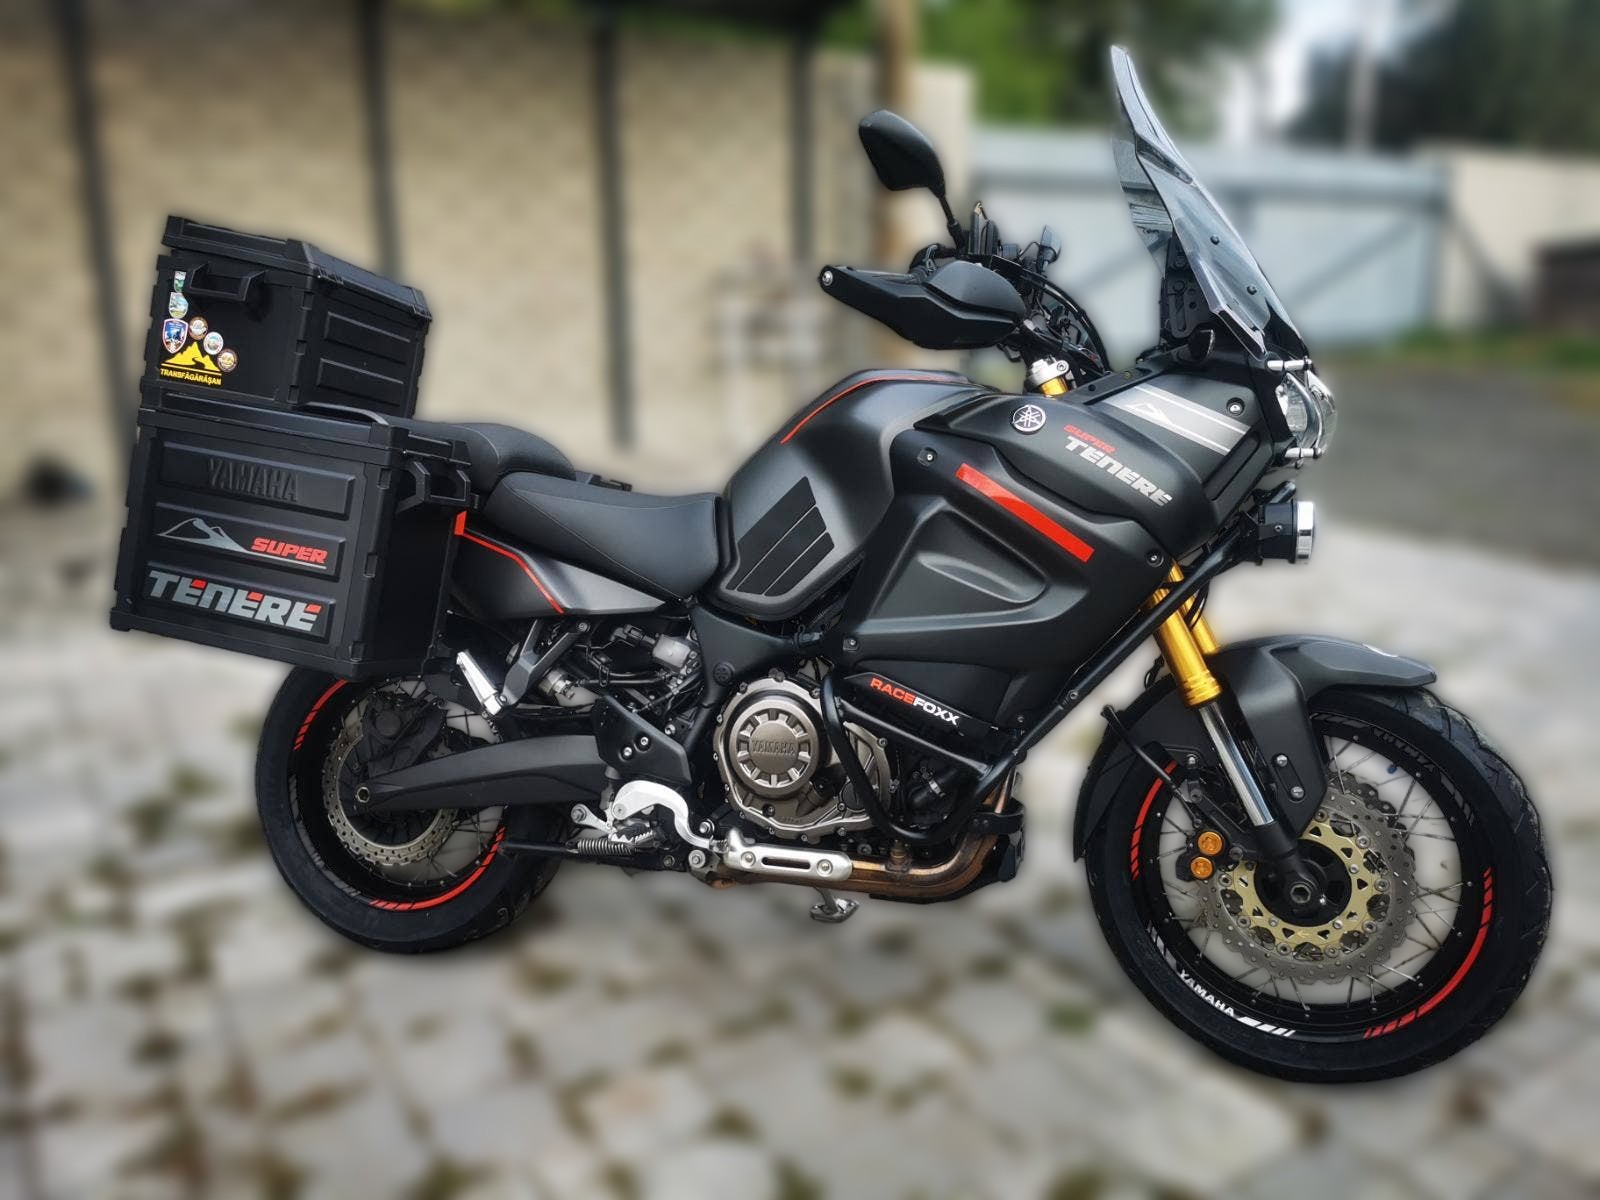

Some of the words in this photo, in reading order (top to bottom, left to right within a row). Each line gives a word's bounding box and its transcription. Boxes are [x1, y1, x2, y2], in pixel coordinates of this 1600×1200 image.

[208, 459, 299, 501] YAMAHA
[1065, 435, 1173, 507] TENERE
[250, 537, 328, 564] SUPER
[149, 570, 322, 632] TENERE
[870, 677, 960, 727] RACEFOXX
[752, 740, 797, 756] YAMAHA
[1180, 969, 1235, 1017] YAMAHA
